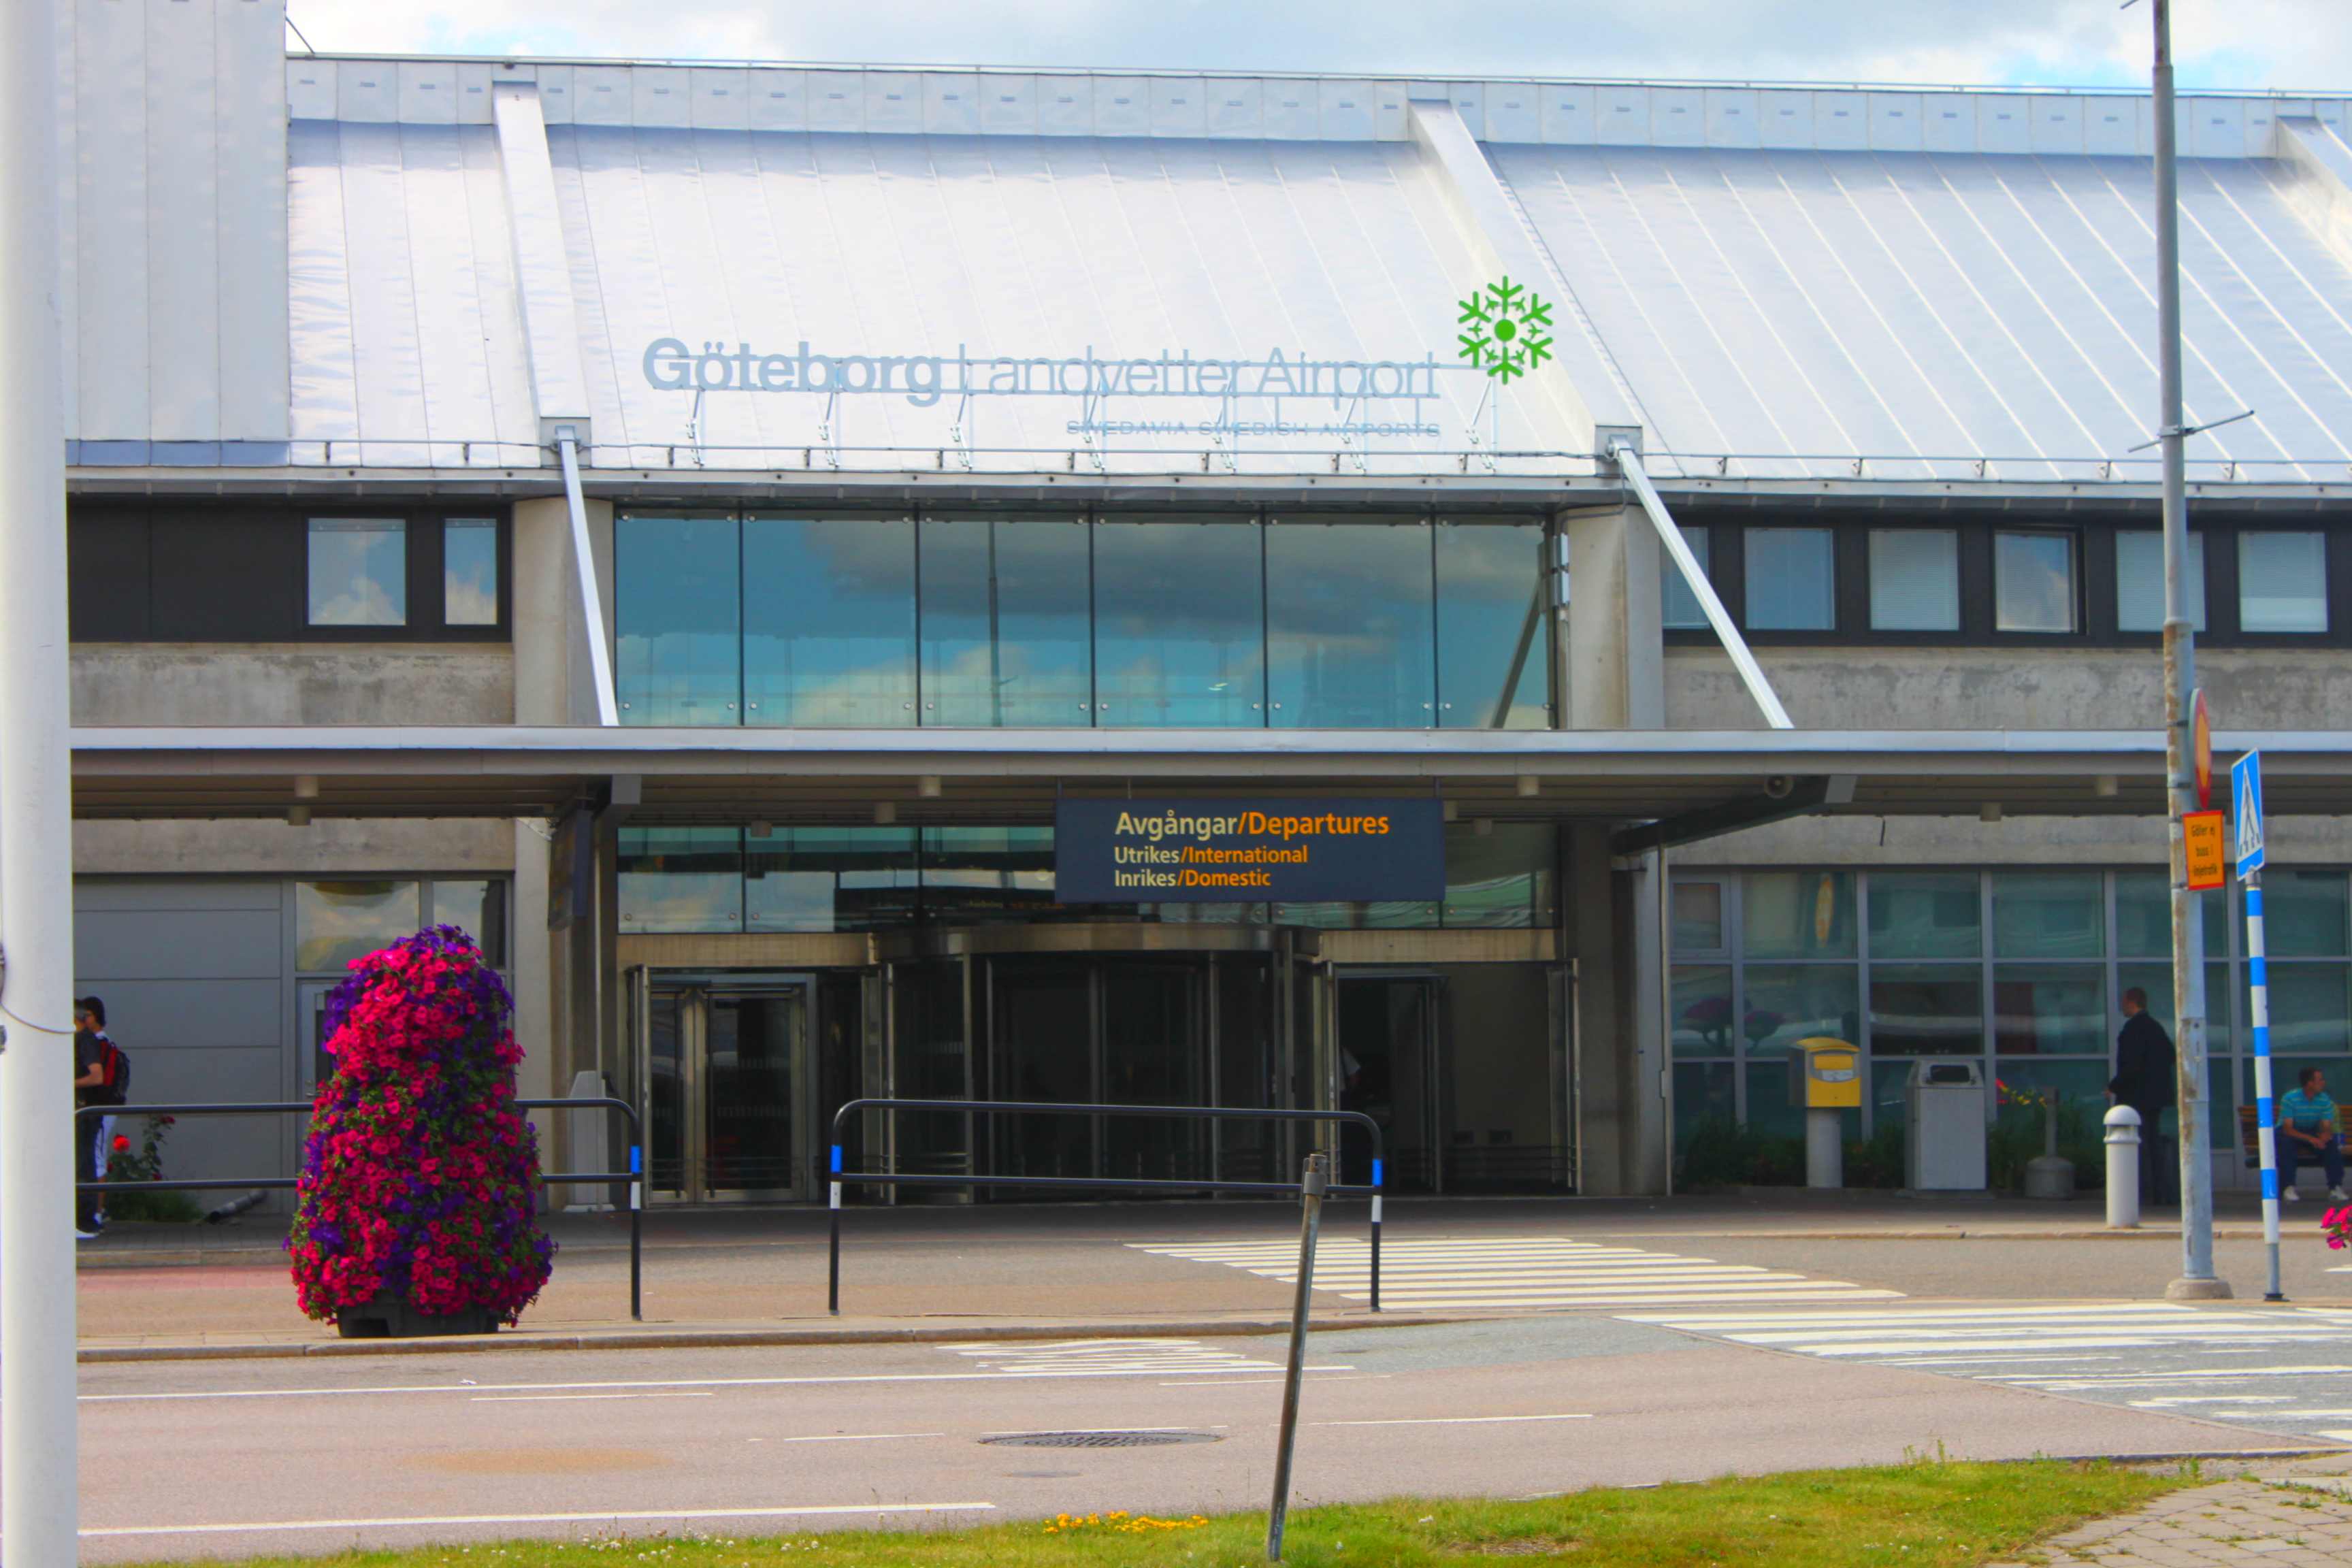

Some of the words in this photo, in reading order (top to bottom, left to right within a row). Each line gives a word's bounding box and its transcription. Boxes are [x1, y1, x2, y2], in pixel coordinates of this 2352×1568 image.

[642, 337, 942, 408] Göteborg
[958, 343, 1245, 396] Landvetter
[1256, 346, 1440, 410] Airport
[1066, 420, 1189, 436] SWEDAVIA
[1198, 421, 1309, 436] SWEDISH
[1320, 422, 1440, 438] AIRPORTS
[1115, 810, 1390, 841] Avgångar/Departures
[1114, 845, 1308, 864] Utrikes/International
[1114, 868, 1271, 887] Inrikes/Domestic
